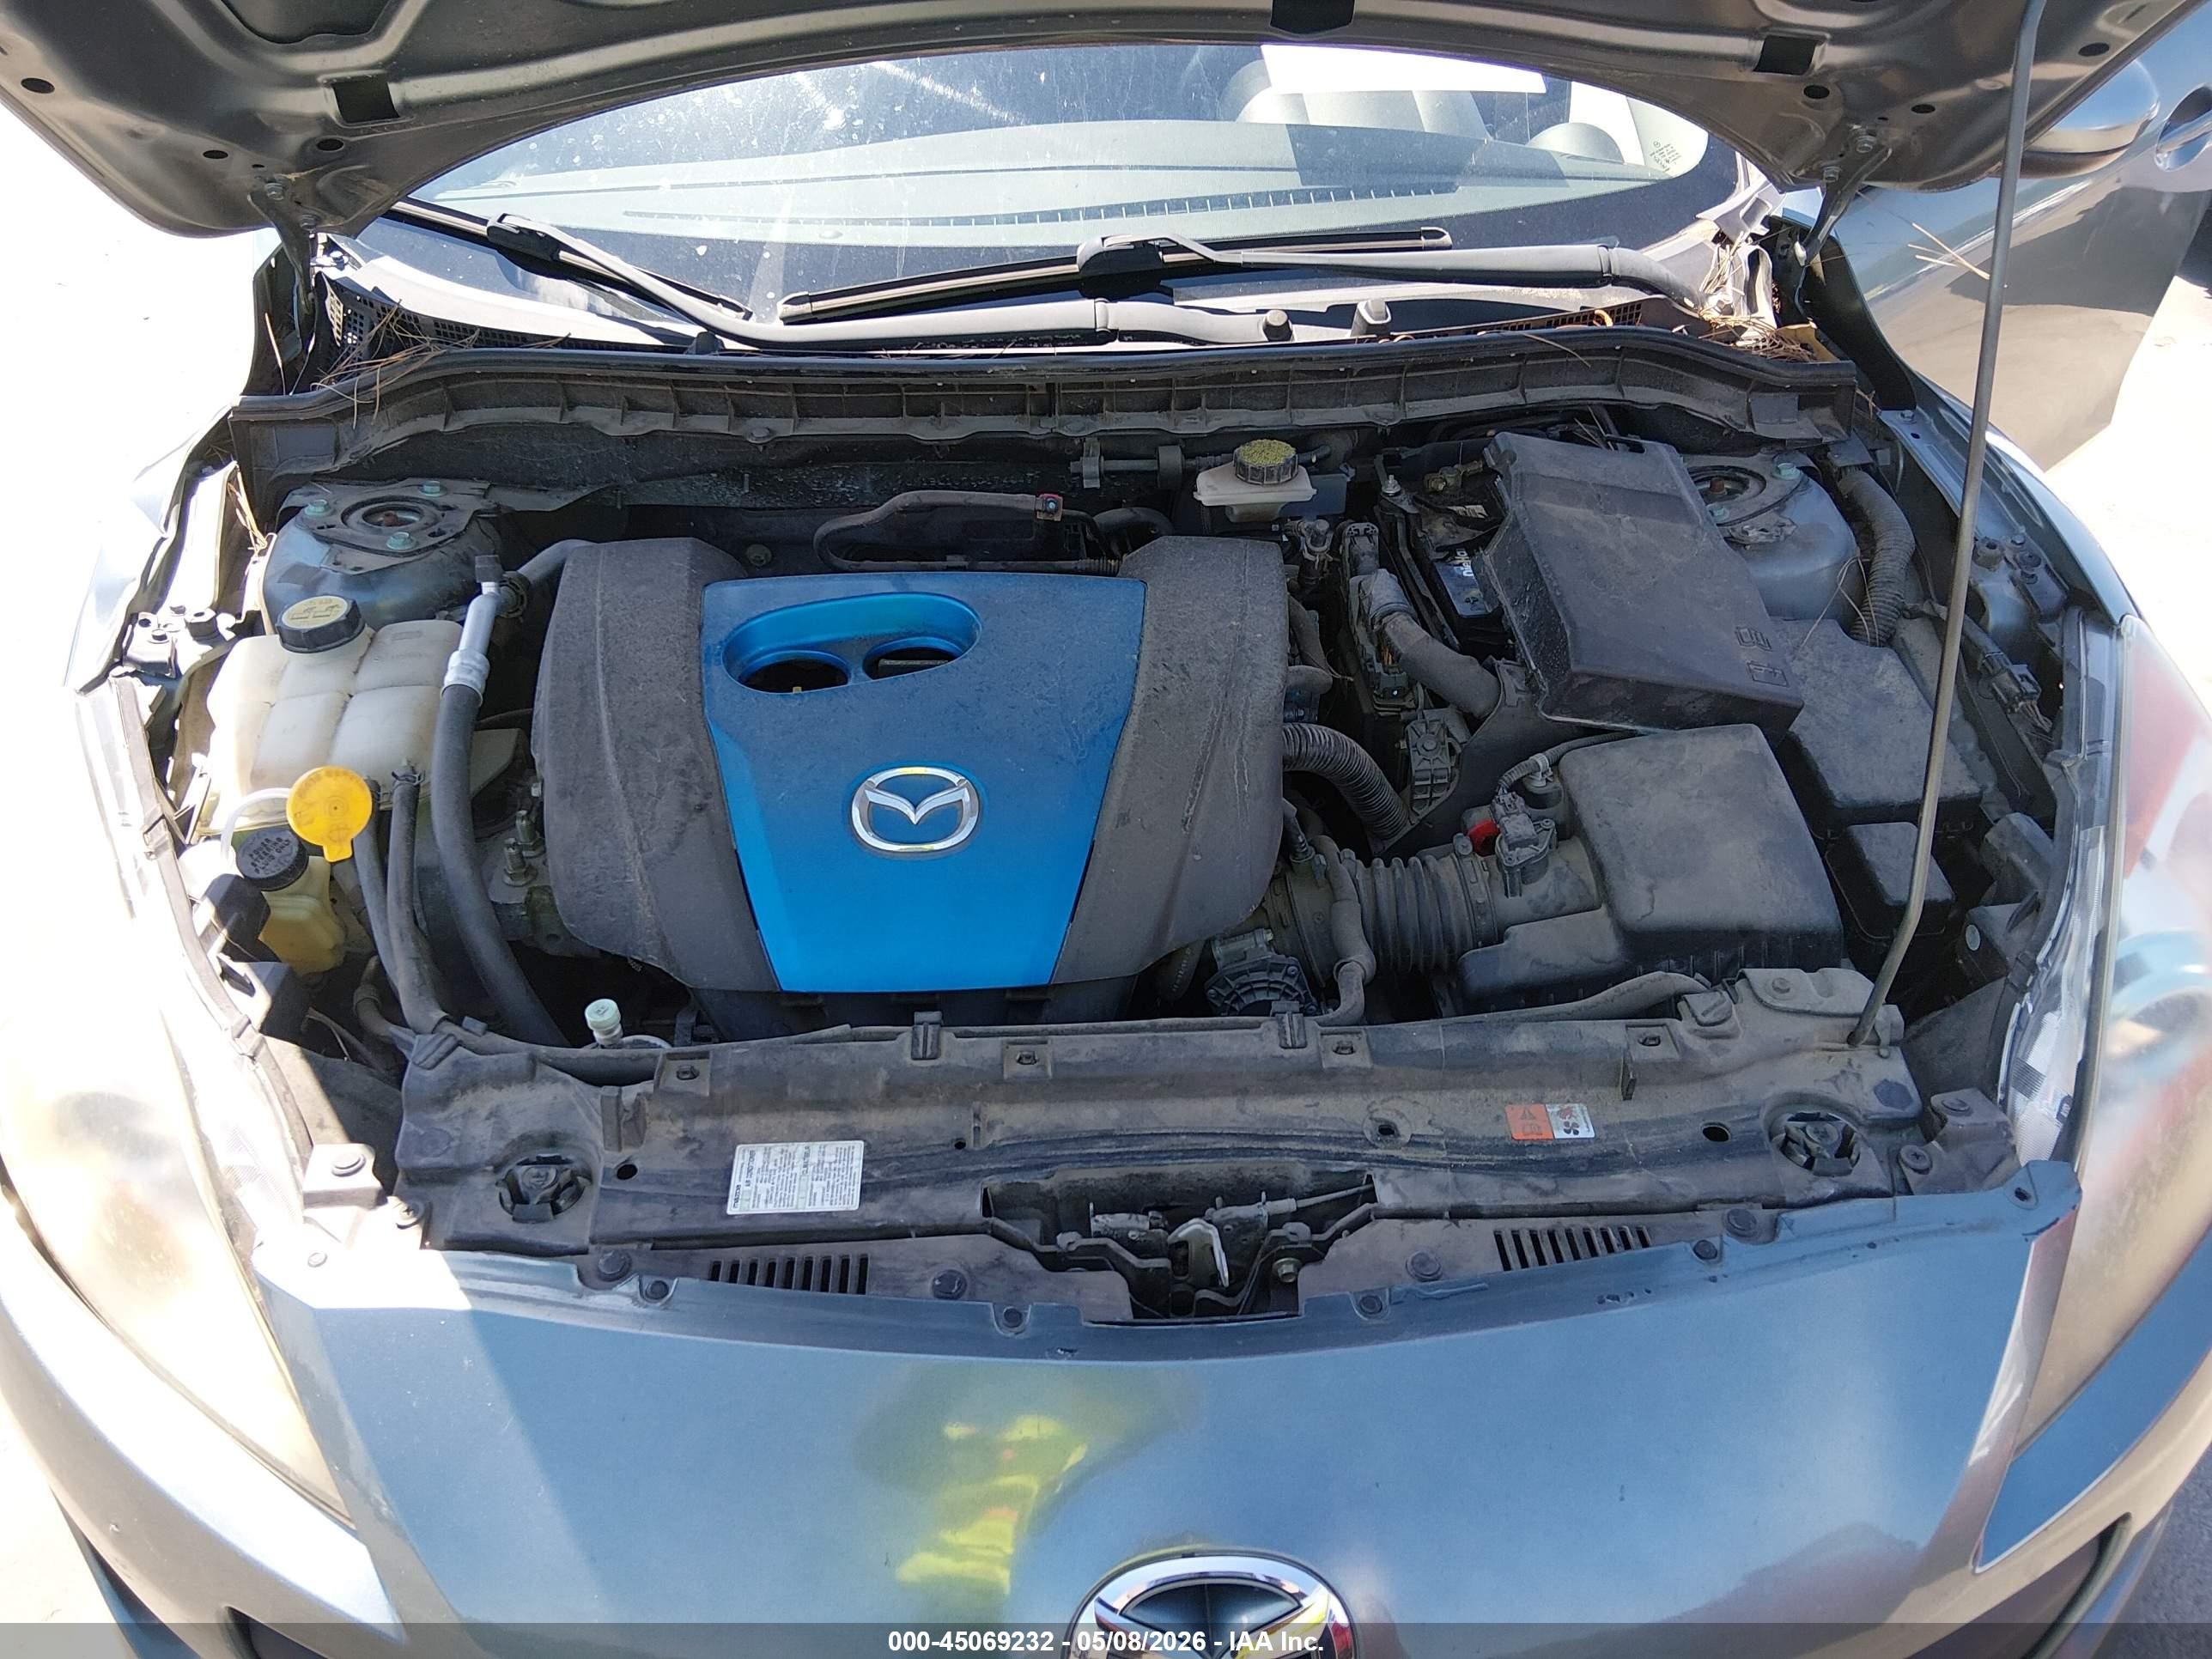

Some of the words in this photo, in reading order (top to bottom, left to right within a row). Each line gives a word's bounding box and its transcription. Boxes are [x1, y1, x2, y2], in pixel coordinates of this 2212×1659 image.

[250, 838, 271, 860] POWER
[251, 837, 283, 867] STEERING
[254, 854, 275, 874] FLUID
[275, 839, 290, 854] ONLY
